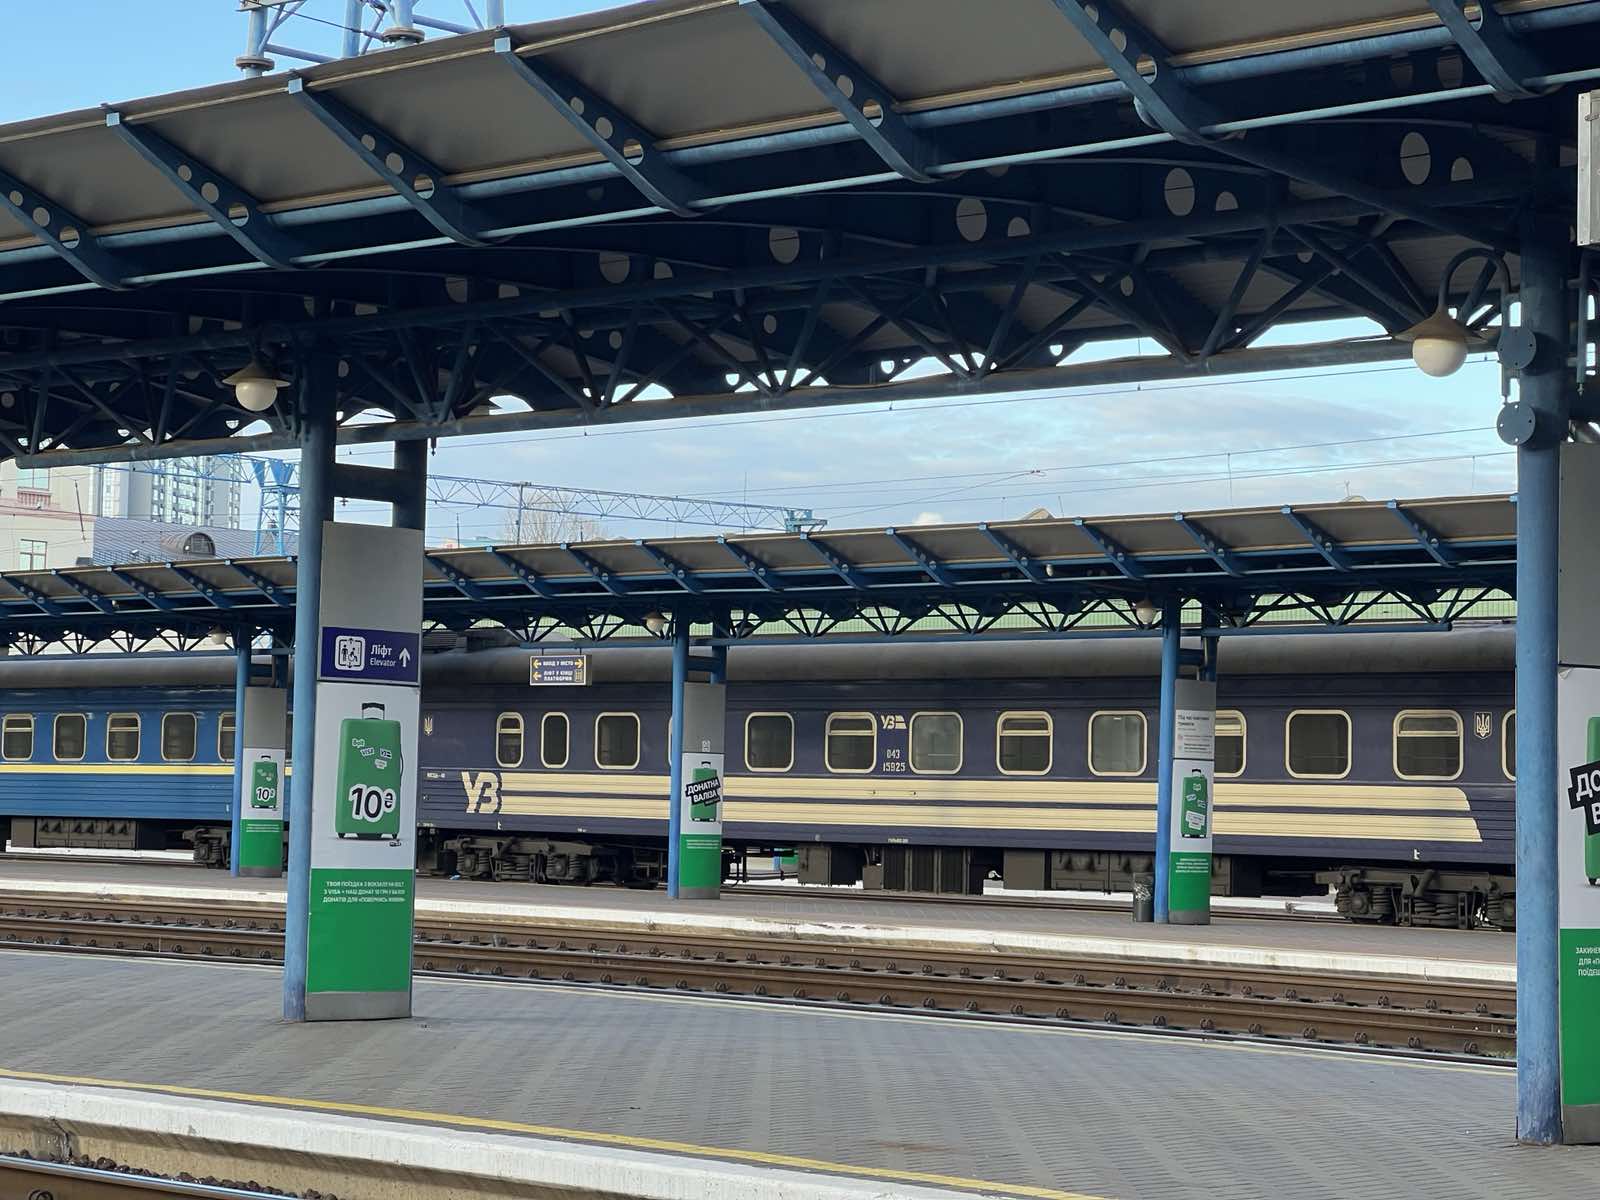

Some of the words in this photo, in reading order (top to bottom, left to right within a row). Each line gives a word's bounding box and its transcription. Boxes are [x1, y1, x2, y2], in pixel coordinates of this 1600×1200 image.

[370, 644, 393, 658] Ліфт
[370, 657, 396, 667] Elevator
[881, 715, 895, 729] УЗ
[883, 762, 906, 772] 15925
[461, 771, 499, 814] УЗ
[687, 779, 720, 796] ДОНАТНА
[693, 789, 717, 803] ВАЛІЗА
